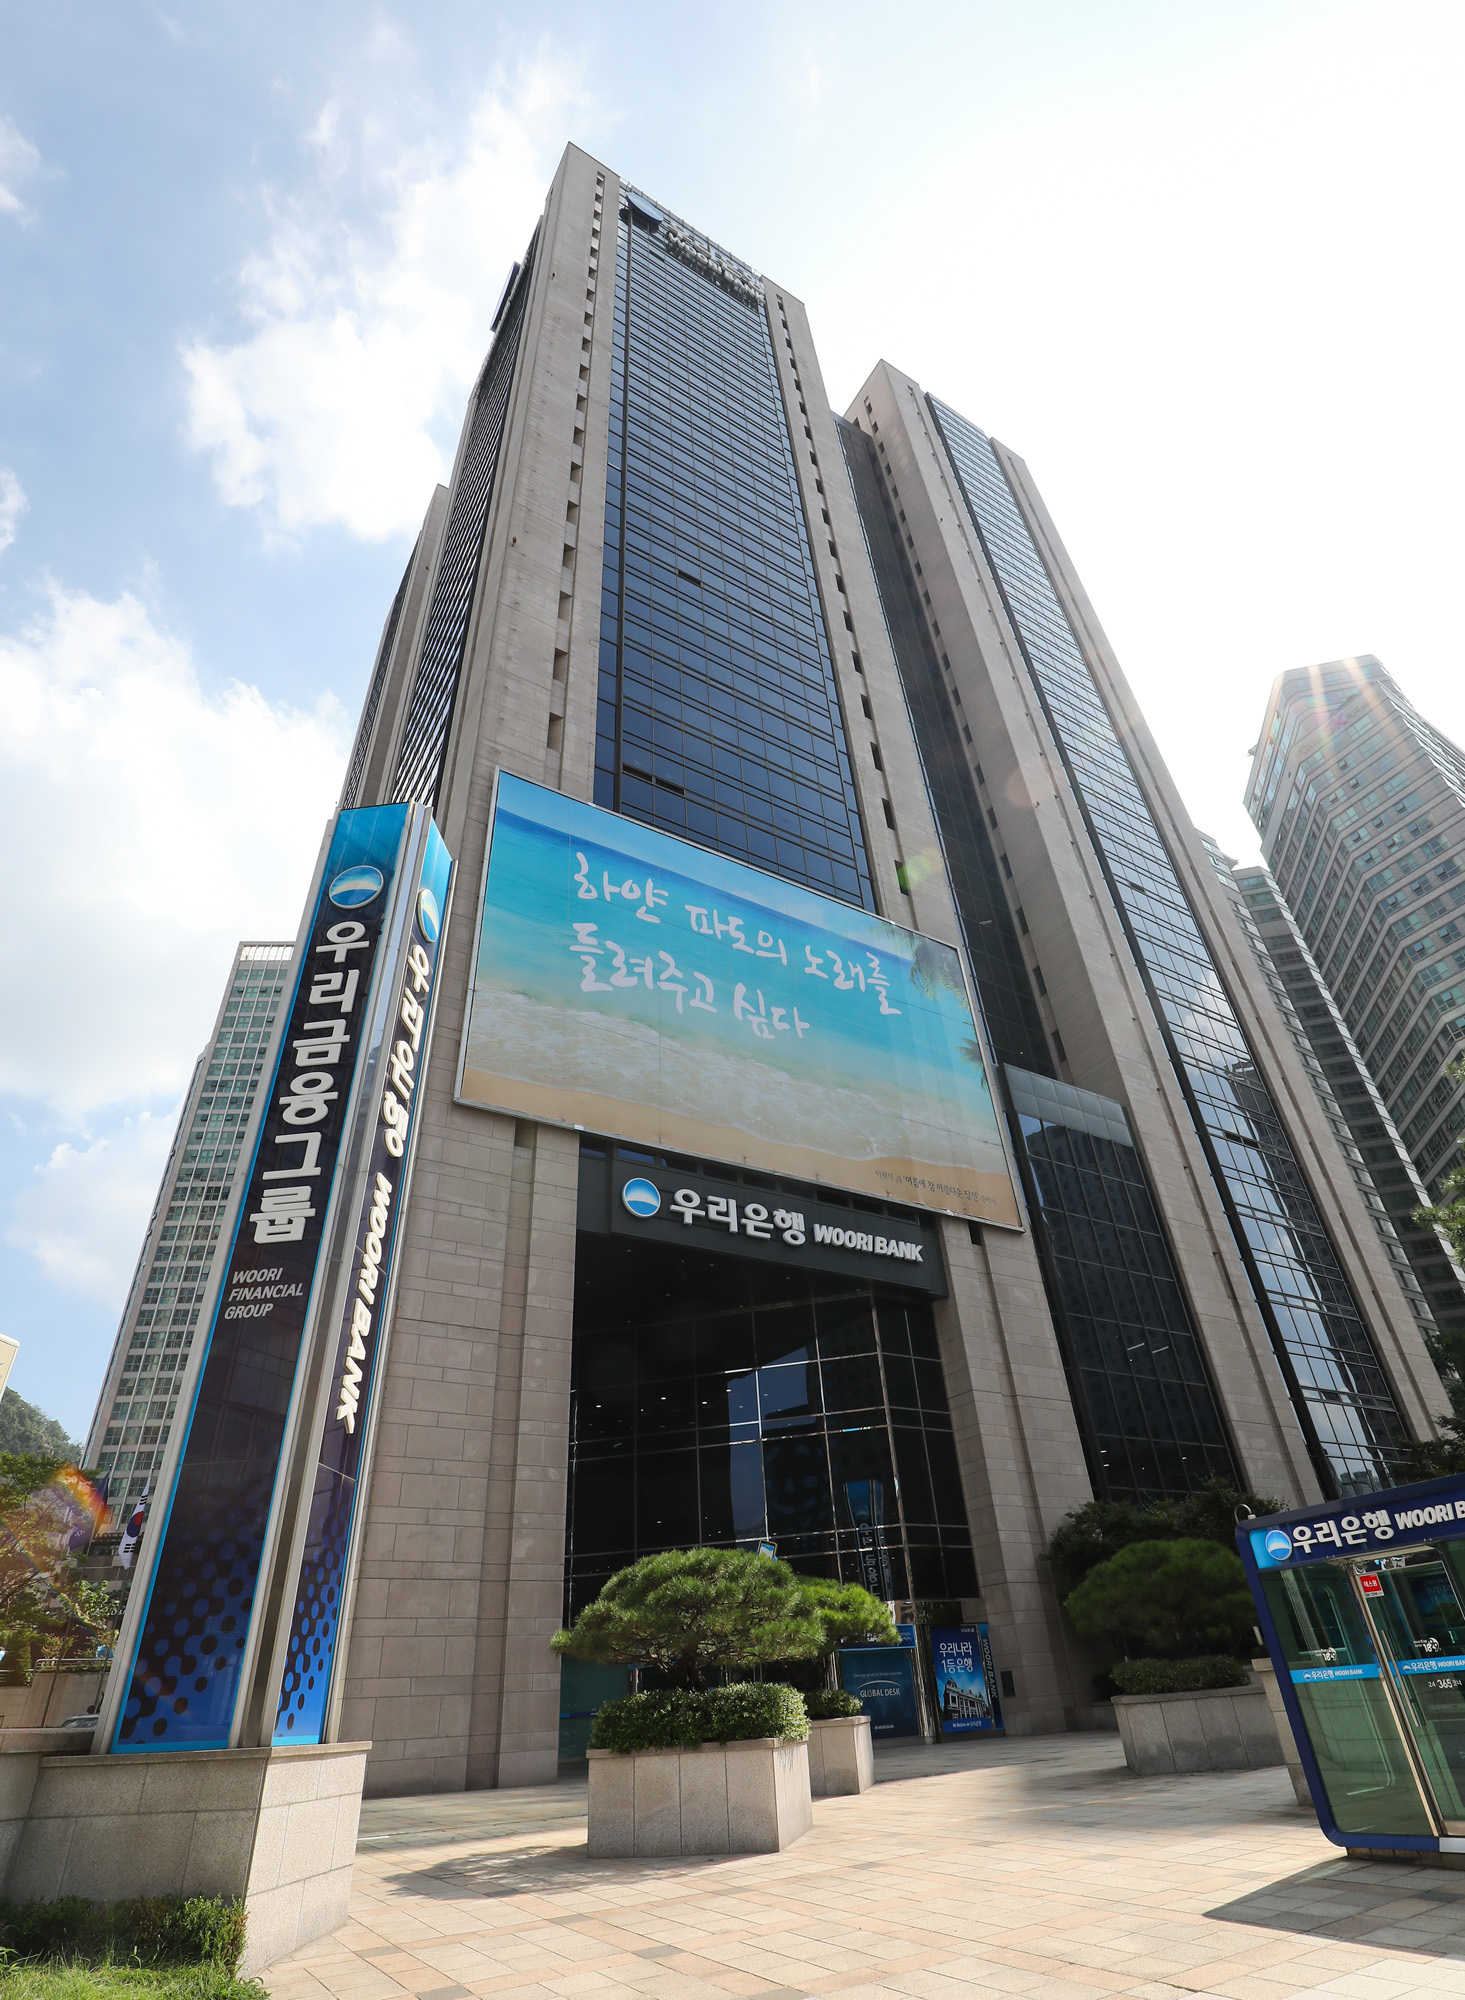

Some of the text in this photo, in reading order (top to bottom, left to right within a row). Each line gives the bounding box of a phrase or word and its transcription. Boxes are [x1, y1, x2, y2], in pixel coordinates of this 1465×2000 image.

[667, 231, 723, 275] WOORI
[573, 851, 902, 1015] 하얀 파도의 노래를
[569, 922, 810, 1039] 들려주고 싶다
[249, 921, 370, 1244] 우리금융그룹
[336, 944, 430, 1434] 우리은행 WOORI BANK
[669, 1188, 924, 1262] 우리은행 WOORI BANK
[228, 1282, 304, 1302] FINANCIAL
[232, 1267, 283, 1285] WOORI
[224, 1303, 274, 1320] GROUP
[1292, 1509, 1395, 1554] 우리은행
[1394, 1503, 1455, 1530] WOORI
[939, 1641, 973, 1657] 우리나라
[982, 1638, 998, 1699] WOORI BANK
[1411, 1659, 1465, 1672] 우리은행 WOORI BAN
[860, 1687, 901, 1698] GLOBAL DESK
[1311, 1669, 1335, 1680] 우리은행
[1350, 1668, 1364, 1676] BANK
